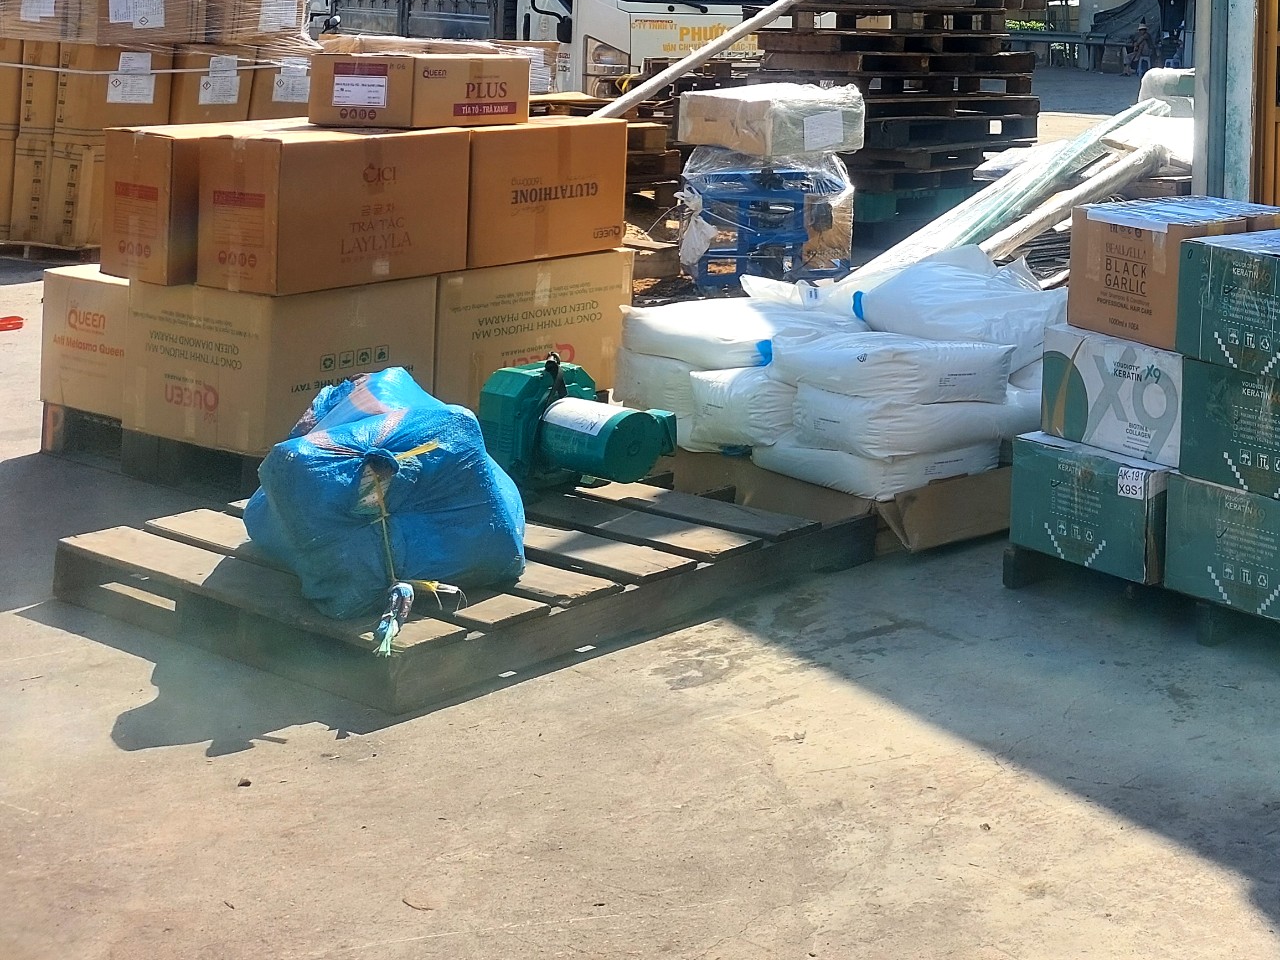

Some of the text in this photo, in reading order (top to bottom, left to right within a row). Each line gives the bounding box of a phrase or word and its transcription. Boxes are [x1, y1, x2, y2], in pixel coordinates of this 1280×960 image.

[422, 68, 447, 79] QUEEN
[465, 82, 508, 99] PLUS
[494, 104, 508, 113] XANH
[511, 182, 598, 205] GLUTATHIONE
[593, 225, 620, 239] QUEEN
[1105, 257, 1147, 279] BLACK
[1232, 267, 1259, 279] KERATIN
[1105, 273, 1147, 295] GARLIC
[478, 300, 599, 327] QUEEN DIAMOND PHARMA
[1096, 297, 1153, 316] PROFESSIONAL HAIR CARE
[67, 309, 106, 331] QUEEN
[472, 311, 602, 341] CÔNG TY TNHH THƯƠNG MẠI
[149, 330, 239, 355] QUEEN DIAMOND PHARMA
[99, 344, 125, 358] Queen
[191, 351, 209, 364] TNHH
[1113, 363, 1161, 384] KERATIN X9
[164, 381, 219, 412] QUEEN
[1242, 388, 1270, 400] KERATIN
[1125, 428, 1151, 439] COLLAGEN
[1128, 422, 1144, 431] BIOTIN
[1118, 469, 1144, 481] AK-191
[1118, 484, 1143, 496] X9S1
[1224, 502, 1253, 515] KERATIN
